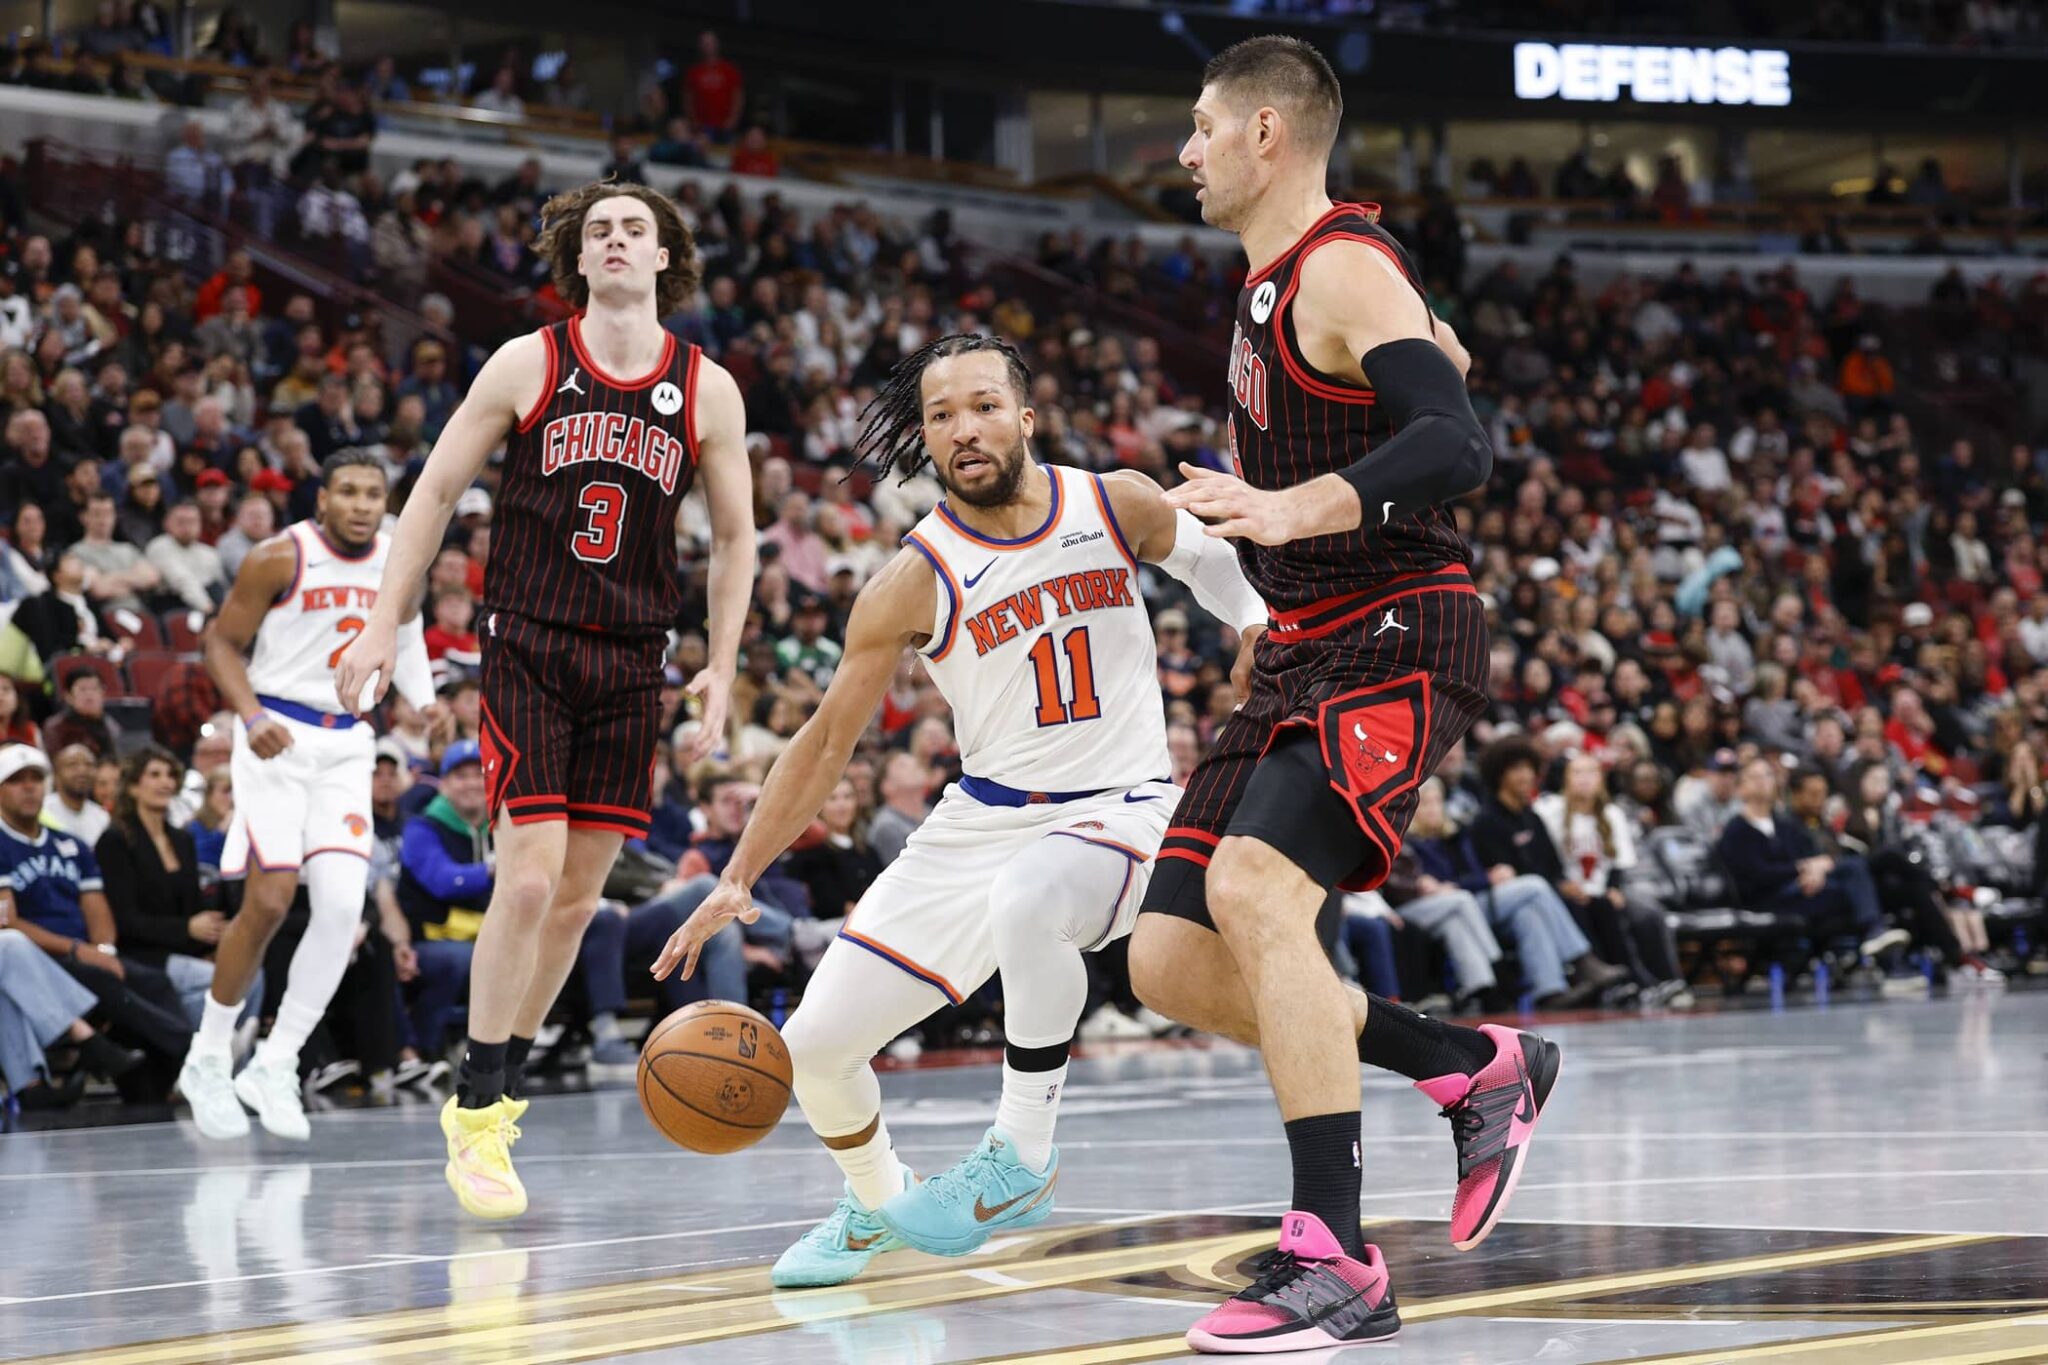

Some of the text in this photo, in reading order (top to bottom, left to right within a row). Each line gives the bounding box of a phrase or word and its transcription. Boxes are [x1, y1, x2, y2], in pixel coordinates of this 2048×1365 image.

[1514, 42, 1791, 106] DEFENSE
[542, 411, 683, 495] CHICAGO
[571, 481, 628, 564] 3
[302, 586, 379, 612] NEW YO
[965, 568, 1134, 657] NEW YORK
[1028, 626, 1101, 728] 11
